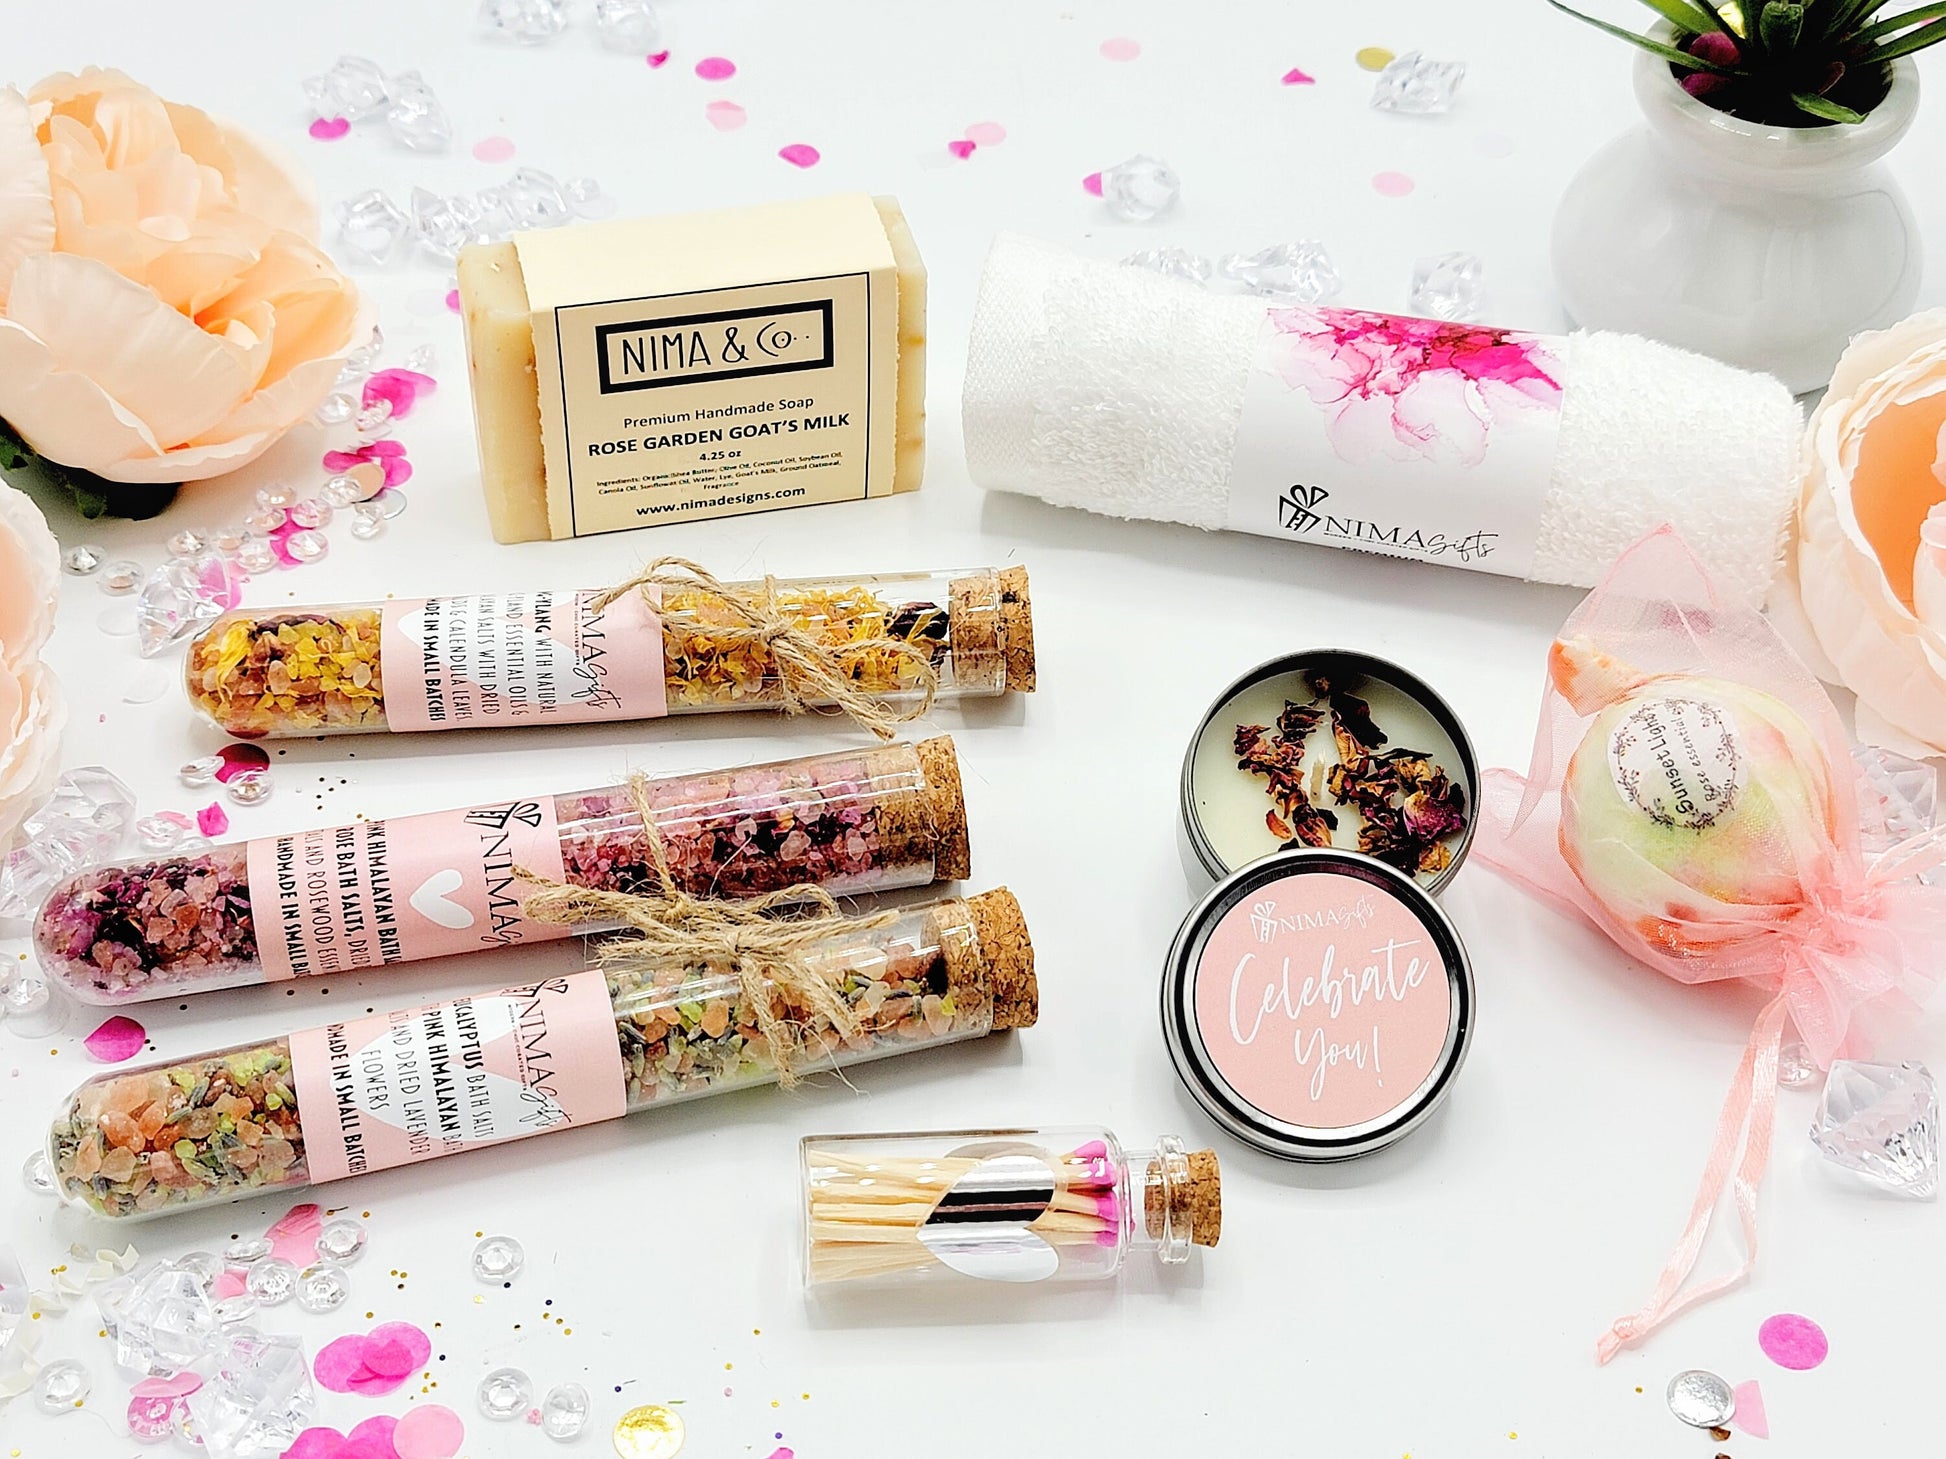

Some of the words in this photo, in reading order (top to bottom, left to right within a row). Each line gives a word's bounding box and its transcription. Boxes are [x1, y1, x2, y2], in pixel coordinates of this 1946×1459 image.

[622, 331, 711, 375] NIMA
[722, 327, 749, 363] &
[624, 413, 690, 428] Premium
[695, 401, 775, 420] Handmade
[779, 398, 814, 410] Soap
[588, 439, 638, 457] ROSE
[643, 429, 723, 450] GARDEN
[804, 413, 850, 431] MILK
[699, 451, 725, 461] 4.25
[728, 450, 742, 458] oz
[636, 487, 806, 516] www.nimadesigns.com
[423, 620, 439, 632] IN
[477, 617, 495, 645] SALTS
[423, 635, 441, 675] SMALL
[449, 619, 468, 686] CALENDULA
[478, 649, 496, 678] WITH
[505, 624, 525, 681] ESSENTIAL
[535, 637, 553, 667] WITH
[424, 678, 446, 721] BATCHES
[479, 684, 500, 715] DRIED
[508, 686, 528, 708] OILS
[536, 672, 557, 714] NATURAL
[1671, 717, 1702, 767] essential
[1655, 750, 1696, 814] Sunset
[304, 845, 324, 866] AND
[336, 852, 359, 889] BATH
[367, 841, 396, 924] HIMALAYAN
[281, 903, 300, 920] IN
[306, 871, 335, 944] ROSEWOOD
[341, 893, 365, 937] SALTS,
[284, 923, 307, 961] SMALL
[377, 927, 401, 956] BATH
[1229, 938, 1430, 1045] Celebrate
[390, 1024, 413, 1046] AND
[422, 1010, 446, 1041] PINK
[452, 997, 484, 1070] EUCALYPTUS
[332, 1064, 352, 1081] IN
[361, 1049, 390, 1111] FLOWERS
[395, 1050, 421, 1095] DRIED
[1294, 1025, 1383, 1101] You!
[335, 1084, 360, 1131] SMALL
[428, 1043, 461, 1132] HIMALAYAN
[466, 1074, 490, 1108] BATH
[403, 1099, 431, 1155] LAVENDER
[472, 1110, 494, 1138] SALTS
